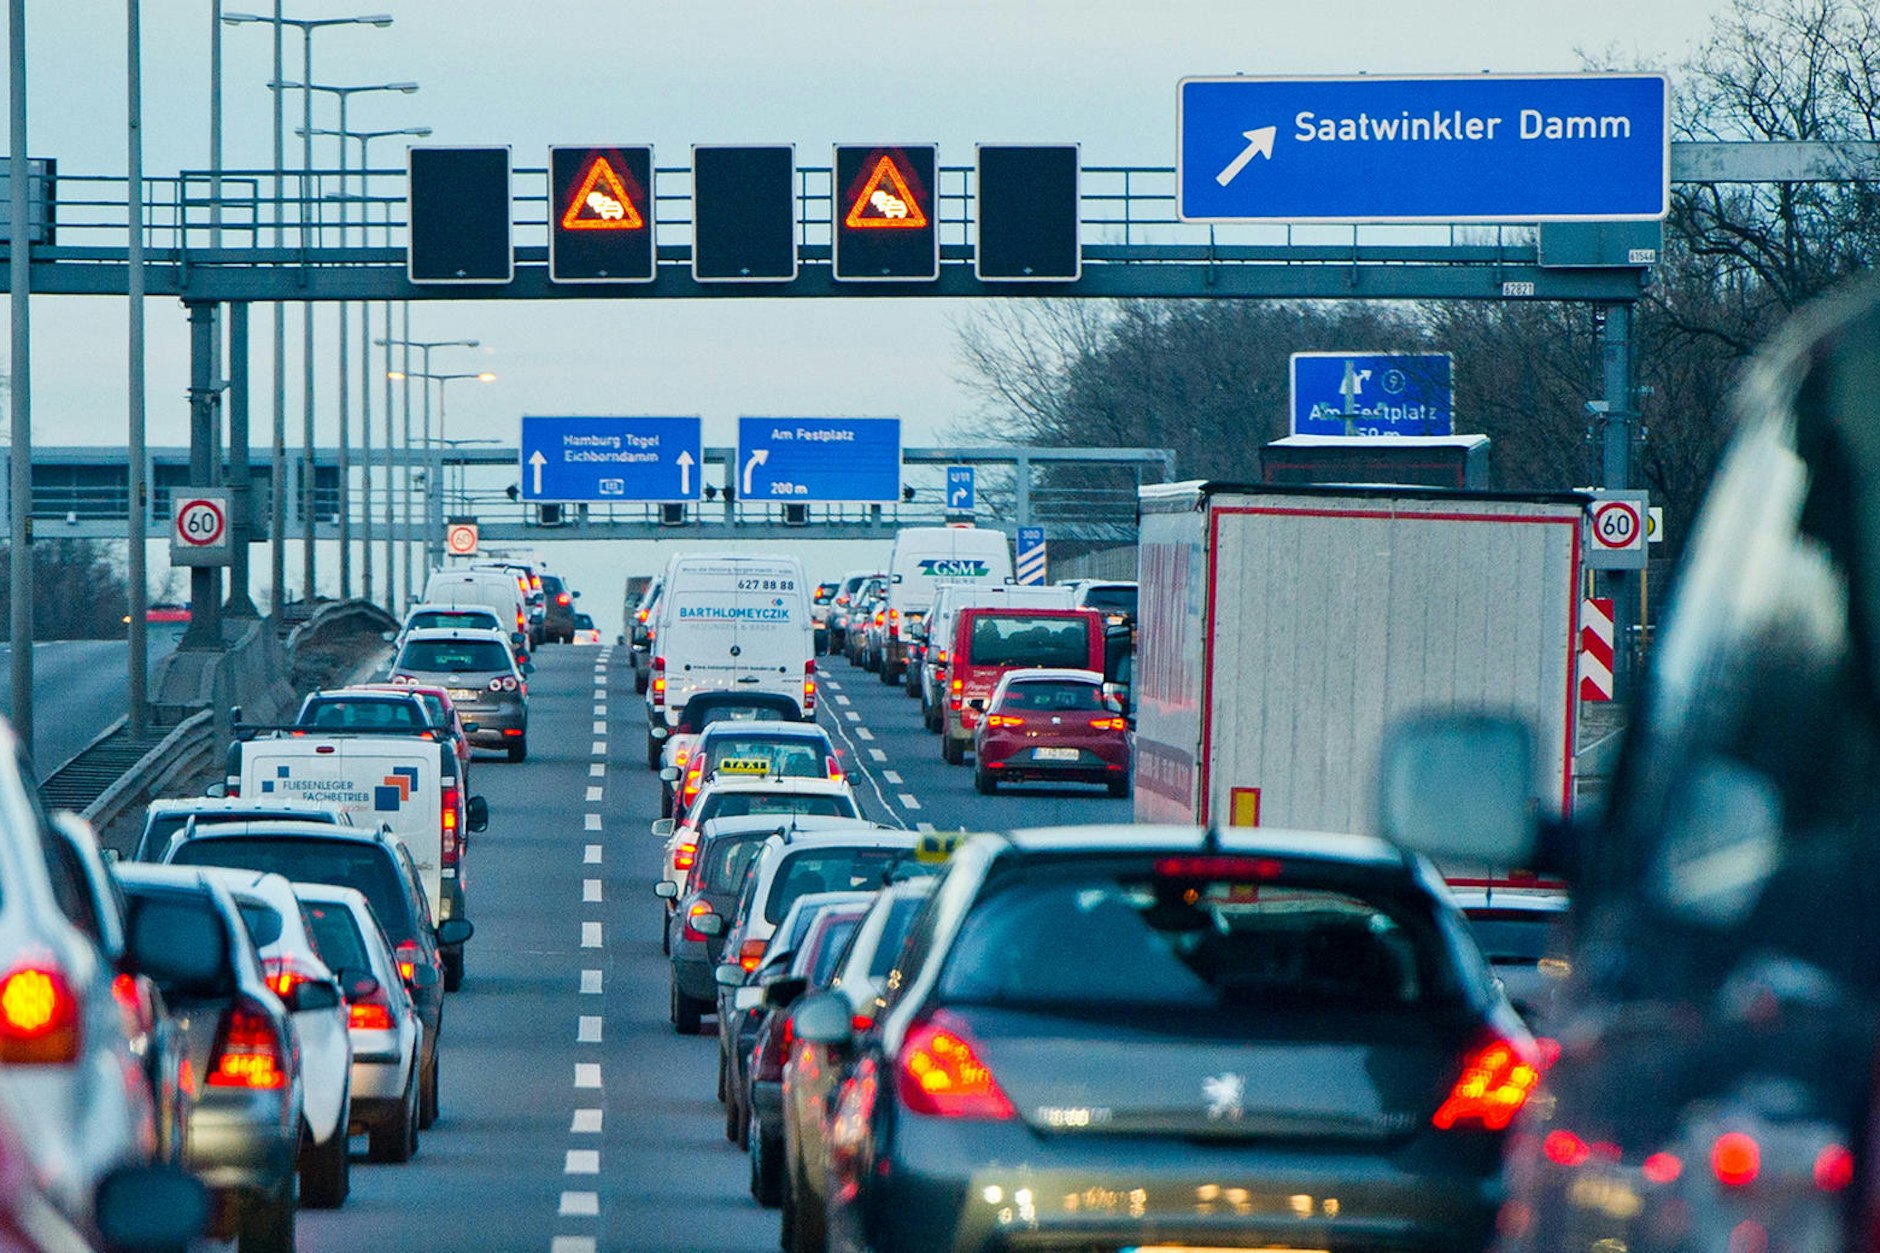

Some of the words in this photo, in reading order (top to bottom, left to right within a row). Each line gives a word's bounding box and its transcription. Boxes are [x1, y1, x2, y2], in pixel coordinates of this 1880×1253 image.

[1295, 110, 1502, 142] Saatwinkler
[1520, 109, 1631, 140] Damm
[563, 435, 621, 449] Hamburg
[625, 434, 660, 449] Tegel
[771, 428, 793, 440] Am
[796, 428, 855, 442] Festplatz
[564, 450, 659, 462] Eichborndamm
[770, 482, 793, 495] 200
[795, 484, 808, 494] m
[188, 512, 215, 534] 60
[1603, 514, 1630, 536] 60
[455, 532, 470, 545] 60
[933, 560, 975, 576] GSM
[738, 580, 759, 590] 627
[763, 581, 777, 590] 88
[780, 581, 794, 591] 88
[680, 607, 789, 619] BARTHLOMEYCZIK
[727, 760, 763, 769] TAXI
[283, 781, 354, 790] FLIESENLEGER
[302, 792, 369, 802] FACHBETRIEB
